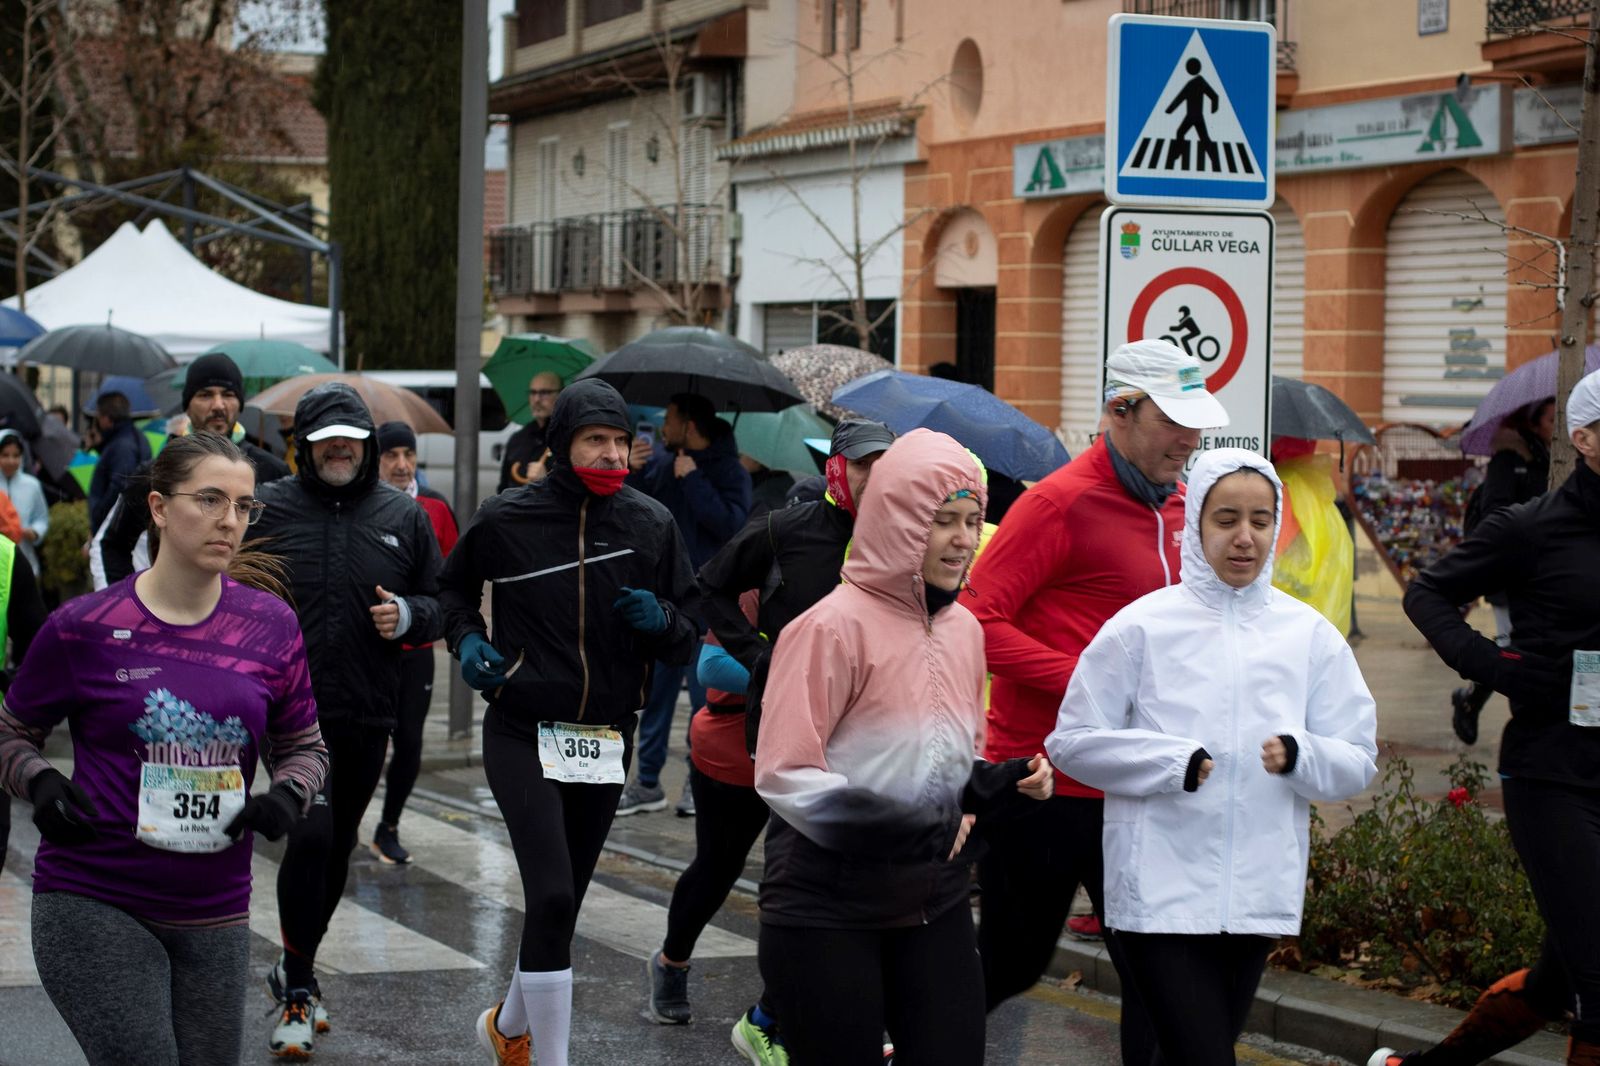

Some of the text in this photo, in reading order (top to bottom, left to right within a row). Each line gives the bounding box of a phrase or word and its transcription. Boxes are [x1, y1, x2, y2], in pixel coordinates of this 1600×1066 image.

[1152, 229, 1219, 237] AYUNTAMIENTO
[1151, 235, 1260, 254] CÚLLAR VEGA
[1214, 437, 1259, 451] MOTOS
[564, 737, 600, 760] 363
[173, 792, 220, 820] 354
[180, 823, 189, 832] La
